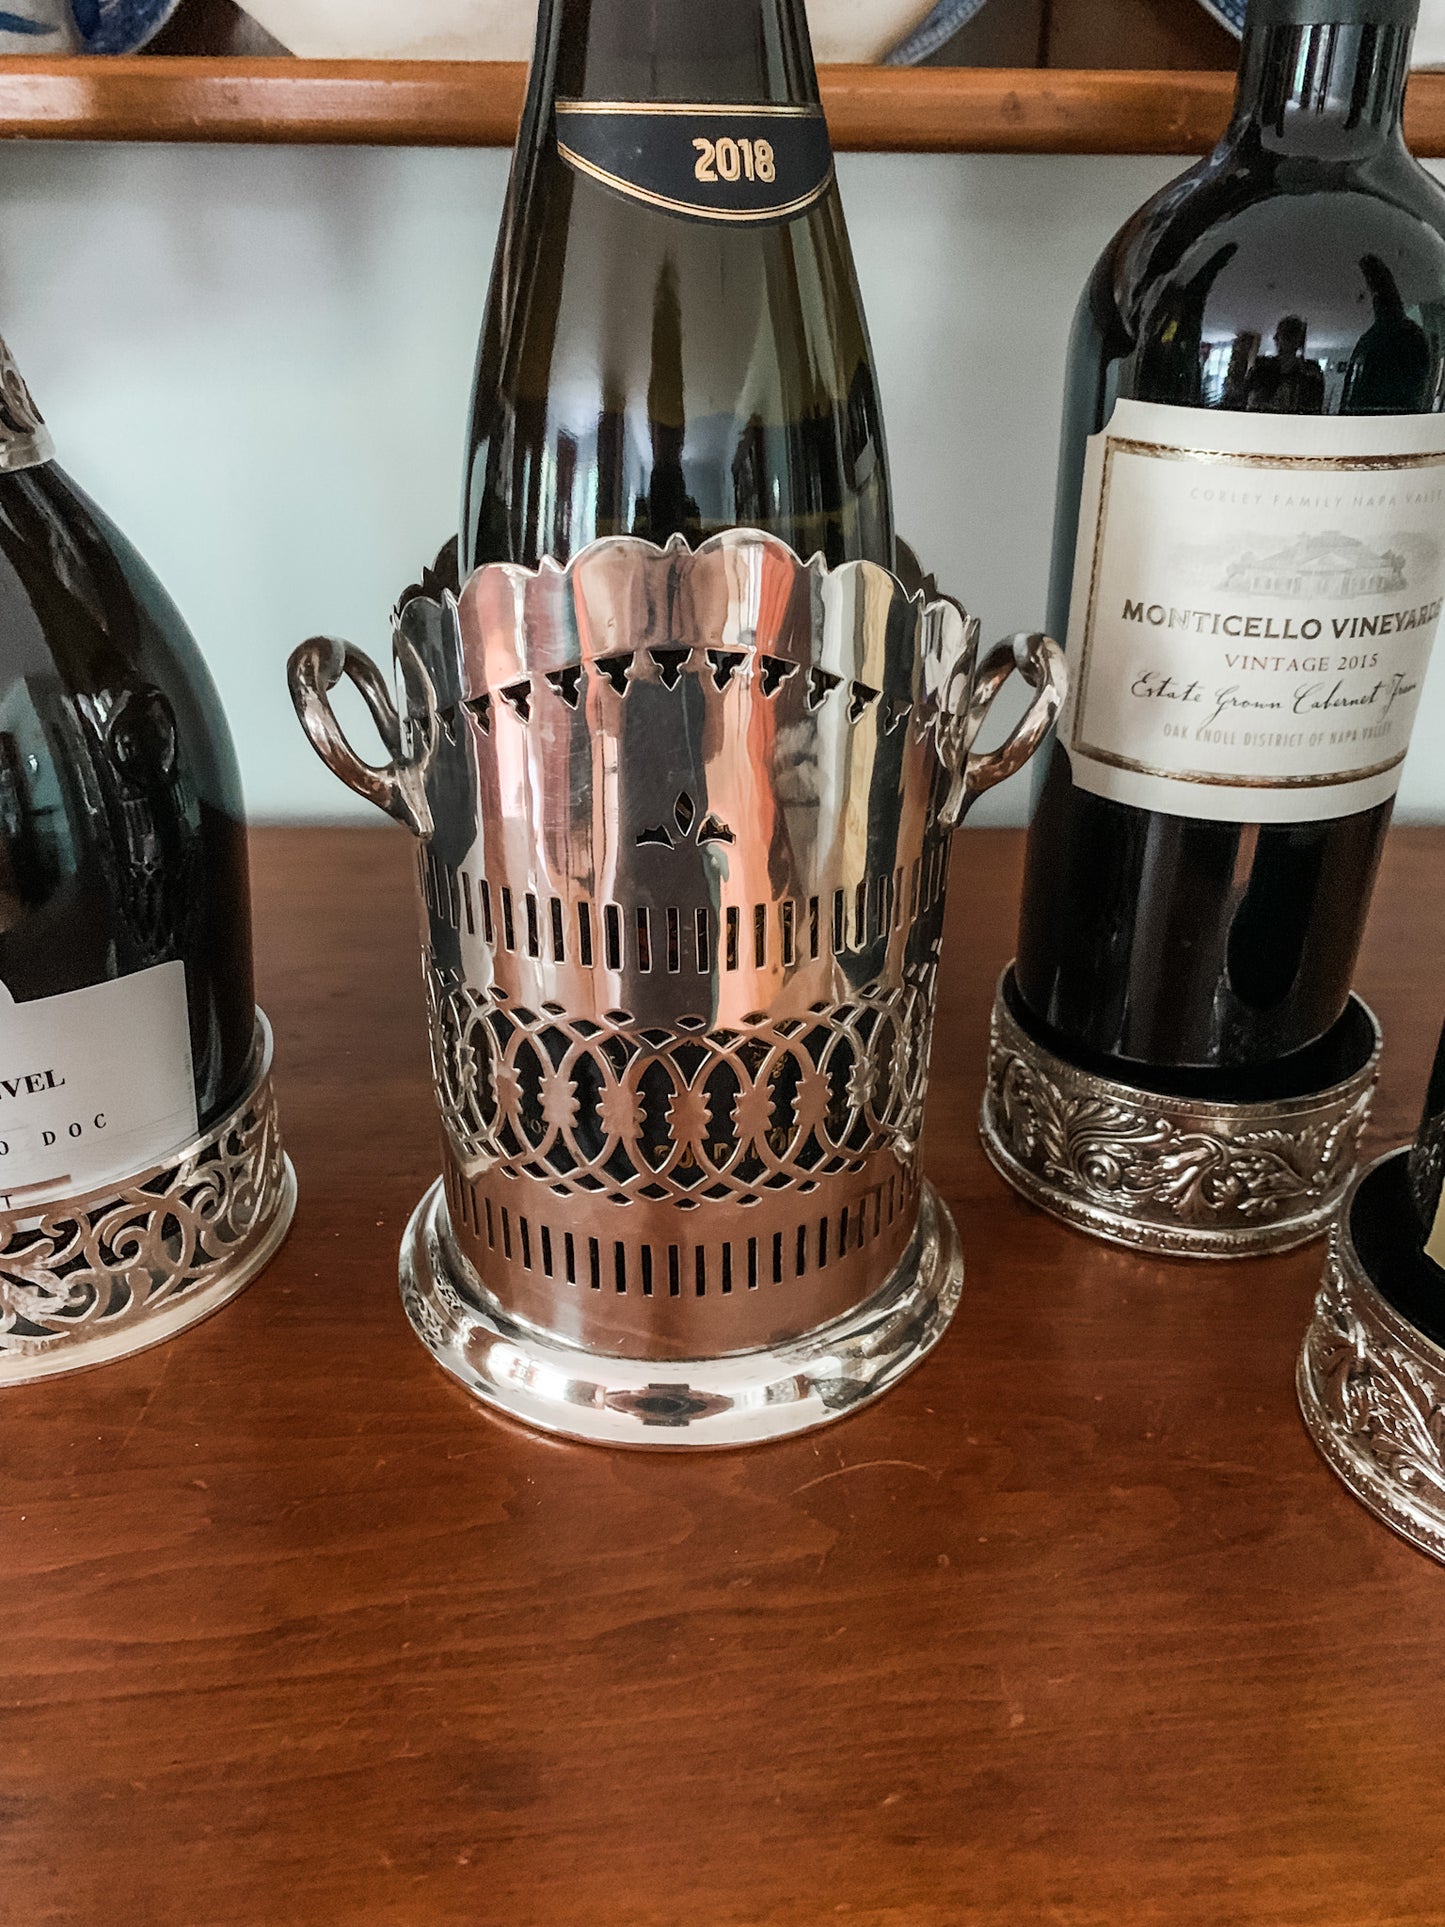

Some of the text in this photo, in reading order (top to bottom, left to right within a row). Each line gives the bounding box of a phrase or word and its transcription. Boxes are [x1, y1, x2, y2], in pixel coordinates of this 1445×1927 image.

[692, 137, 776, 183] 2018
[1189, 486, 1262, 505] CORLEY
[1273, 494, 1342, 508] FAMILY
[1352, 495, 1398, 508] NAPA
[1122, 599, 1322, 640] MONTICELLO
[1225, 653, 1378, 672] VINTAGE 2015
[1131, 671, 1205, 702] Estate
[1199, 685, 1283, 732] Grown
[1293, 679, 1388, 714] Cabernet
[1163, 723, 1189, 739] OAK
[1196, 729, 1236, 746] KNOLL
[1243, 732, 1303, 748] DISTRICT
[1309, 732, 1324, 747] OF
[1328, 728, 1358, 745] NAPA
[0, 1069, 66, 1100] VEL
[42, 1113, 107, 1146] DOC
